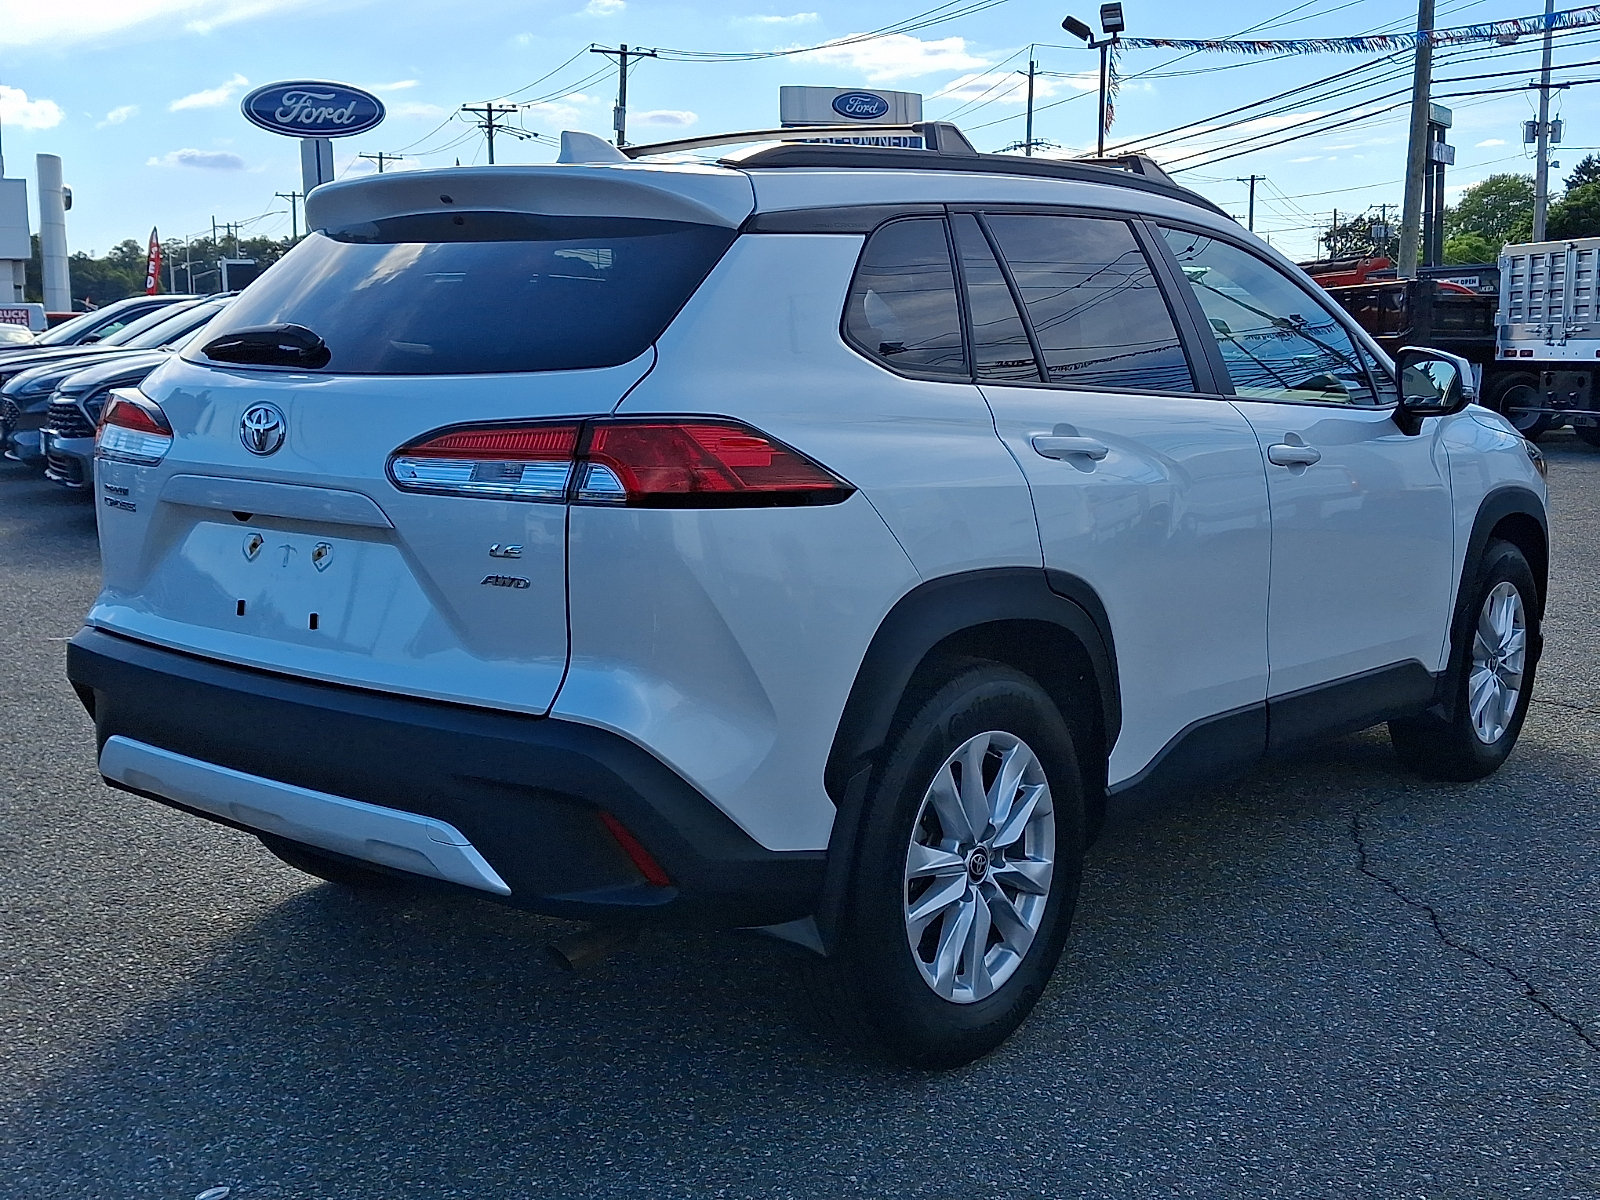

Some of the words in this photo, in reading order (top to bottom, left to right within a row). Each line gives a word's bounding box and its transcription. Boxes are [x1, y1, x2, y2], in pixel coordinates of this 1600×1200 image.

[275, 90, 357, 124] Ford
[845, 96, 879, 114] Ford
[488, 543, 524, 559] LE
[480, 574, 531, 589] AWD
